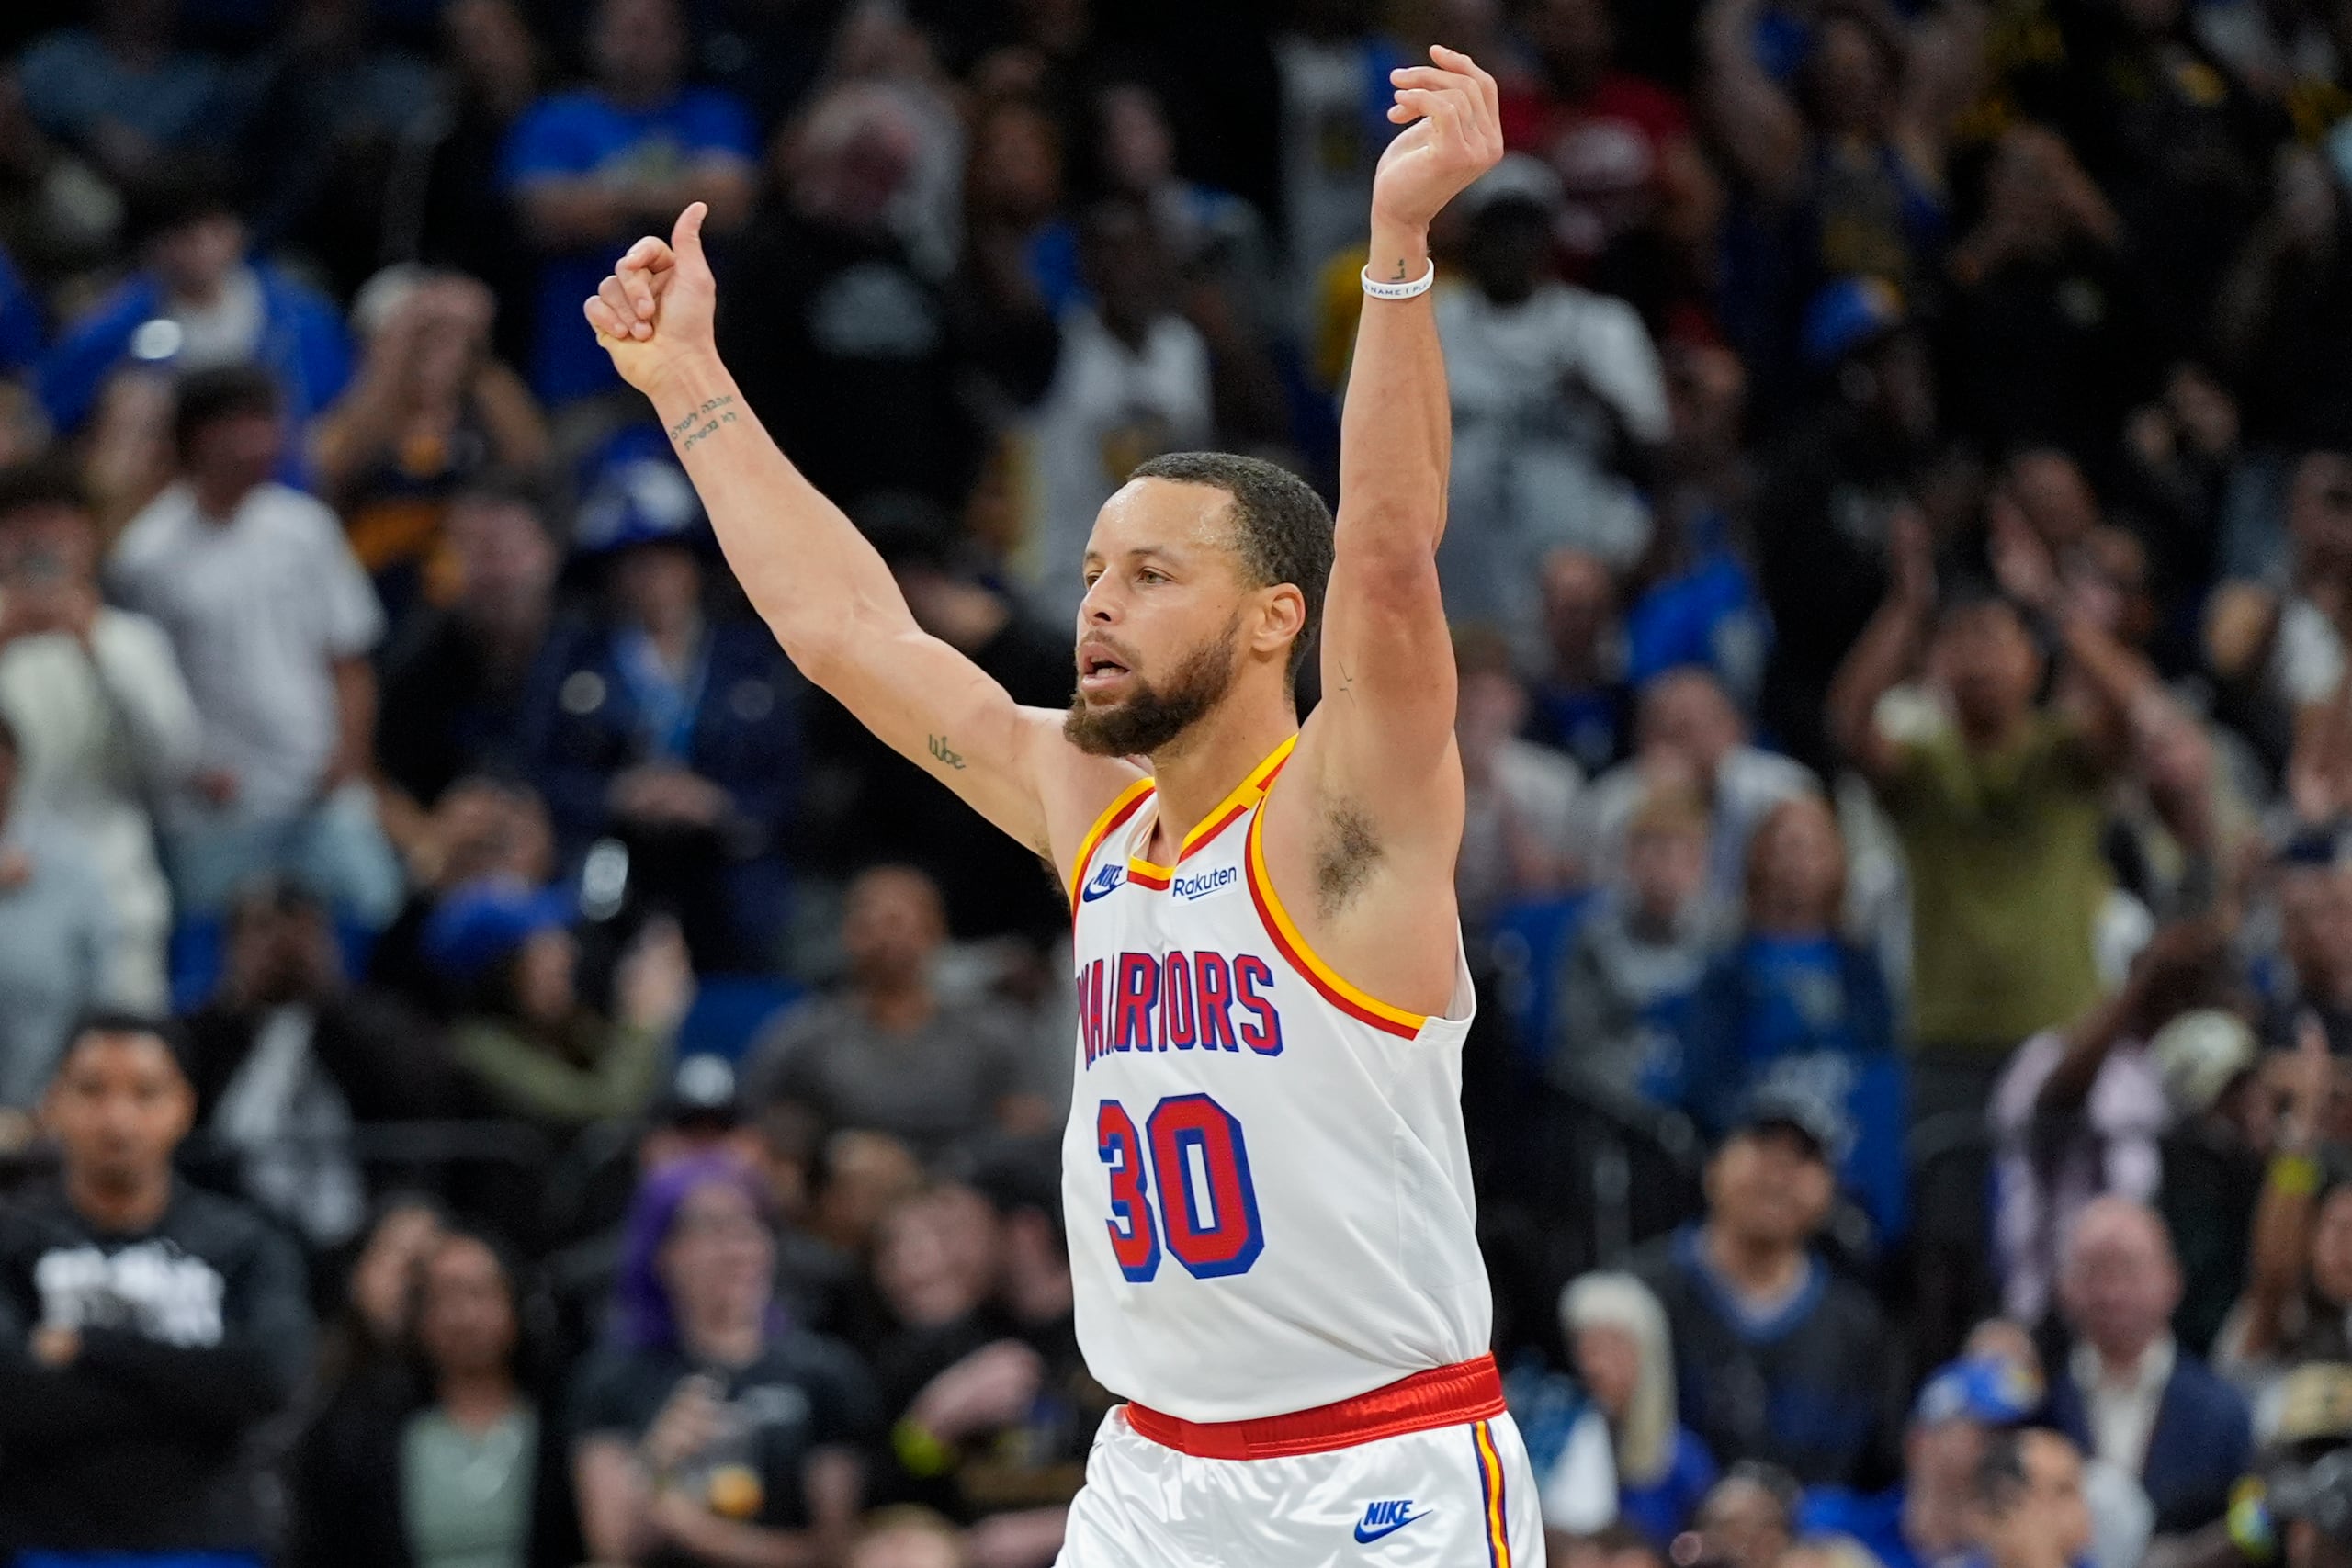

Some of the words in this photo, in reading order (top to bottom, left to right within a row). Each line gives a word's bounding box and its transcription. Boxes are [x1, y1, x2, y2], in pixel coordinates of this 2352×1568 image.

[1371, 287, 1401, 296] NAME
[1093, 863, 1124, 889] NIKE
[1172, 866, 1237, 897] Rakuten
[1077, 950, 1283, 1072] WARIORS
[1097, 1092, 1265, 1283] 30
[1363, 1499, 1413, 1526] NIKE
